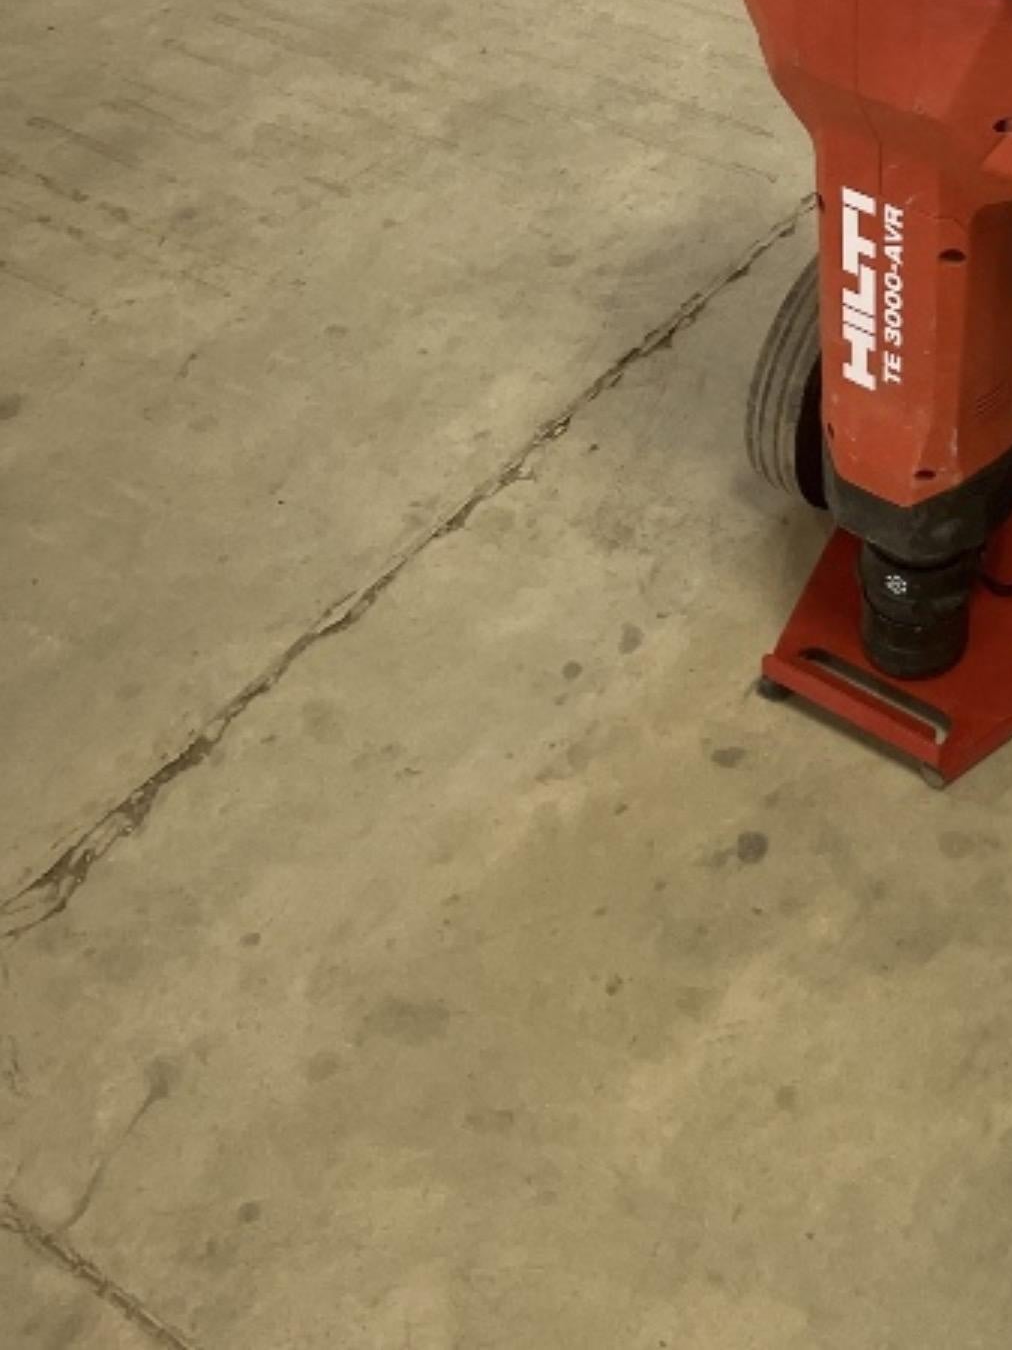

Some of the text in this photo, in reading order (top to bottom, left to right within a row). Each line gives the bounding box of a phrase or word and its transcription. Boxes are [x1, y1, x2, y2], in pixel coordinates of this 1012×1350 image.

[841, 187, 876, 391] HILTI
[883, 203, 904, 384] TE 3000-AVR
